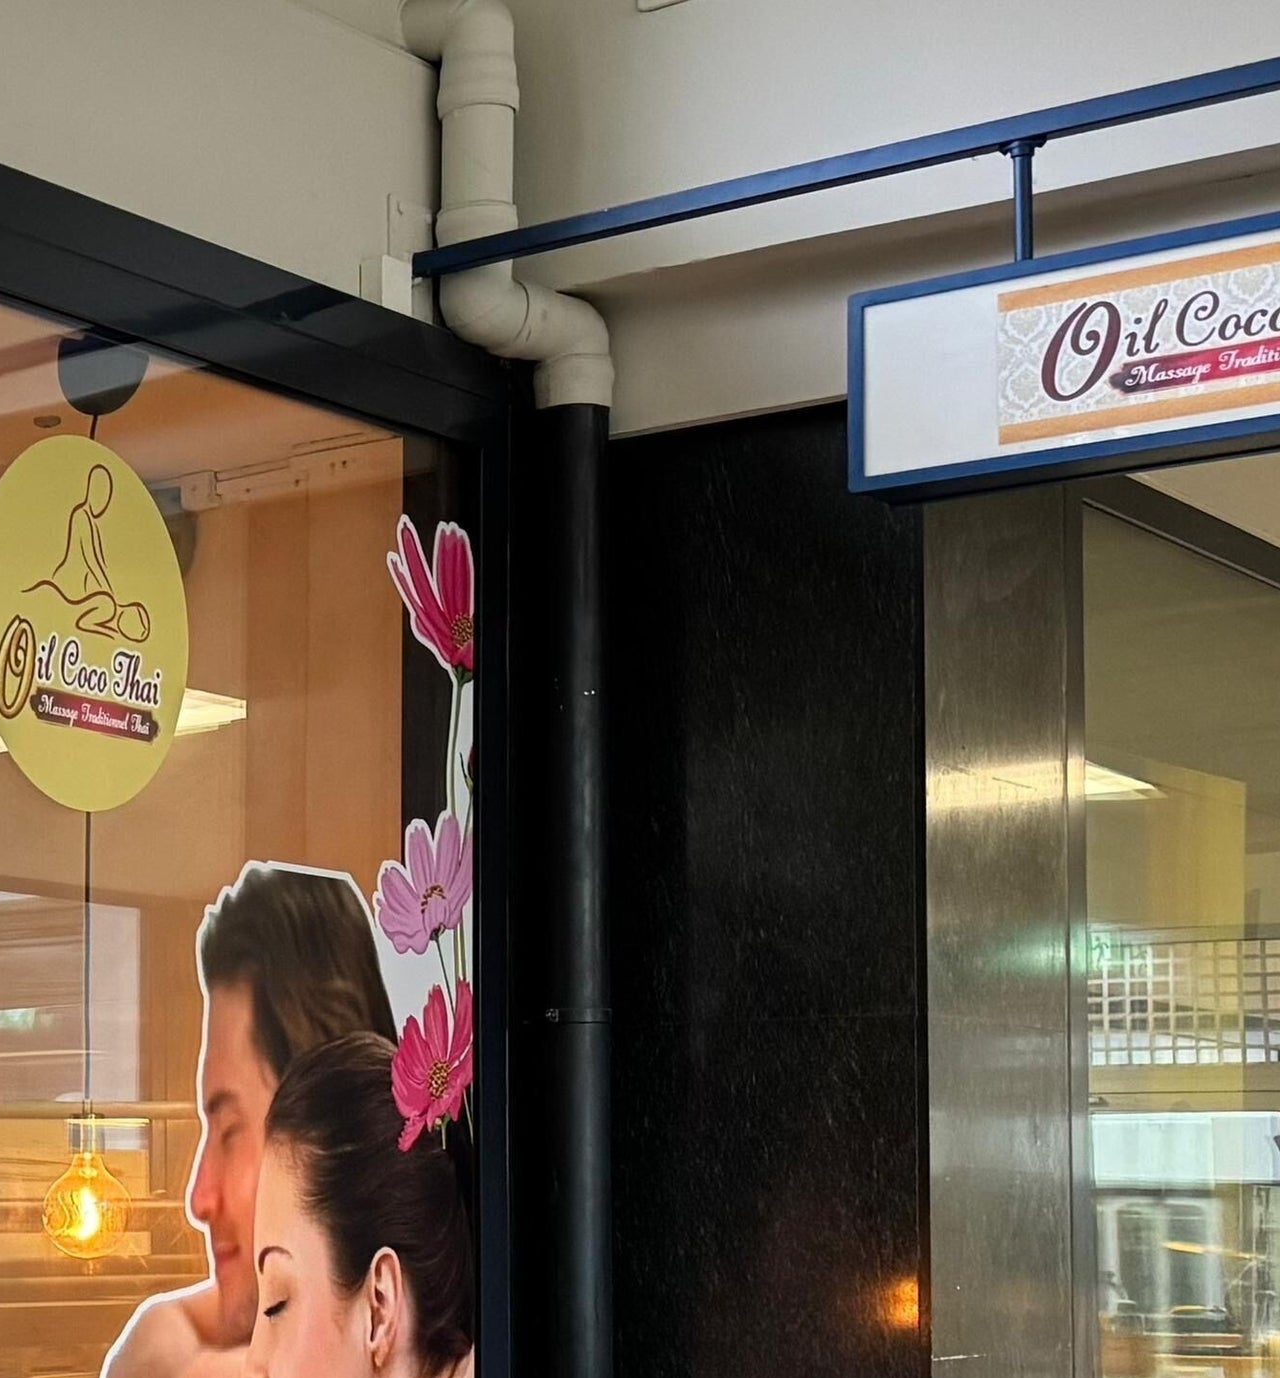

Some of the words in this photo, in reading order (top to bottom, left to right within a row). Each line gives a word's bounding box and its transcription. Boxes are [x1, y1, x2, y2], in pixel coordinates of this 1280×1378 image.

[1041, 299, 1168, 402] Oil
[1125, 363, 1211, 386] Massage
[61, 640, 107, 693] Coco
[113, 651, 161, 705] Thai
[38, 695, 78, 727] Massage
[81, 703, 128, 731] Traditionnel
